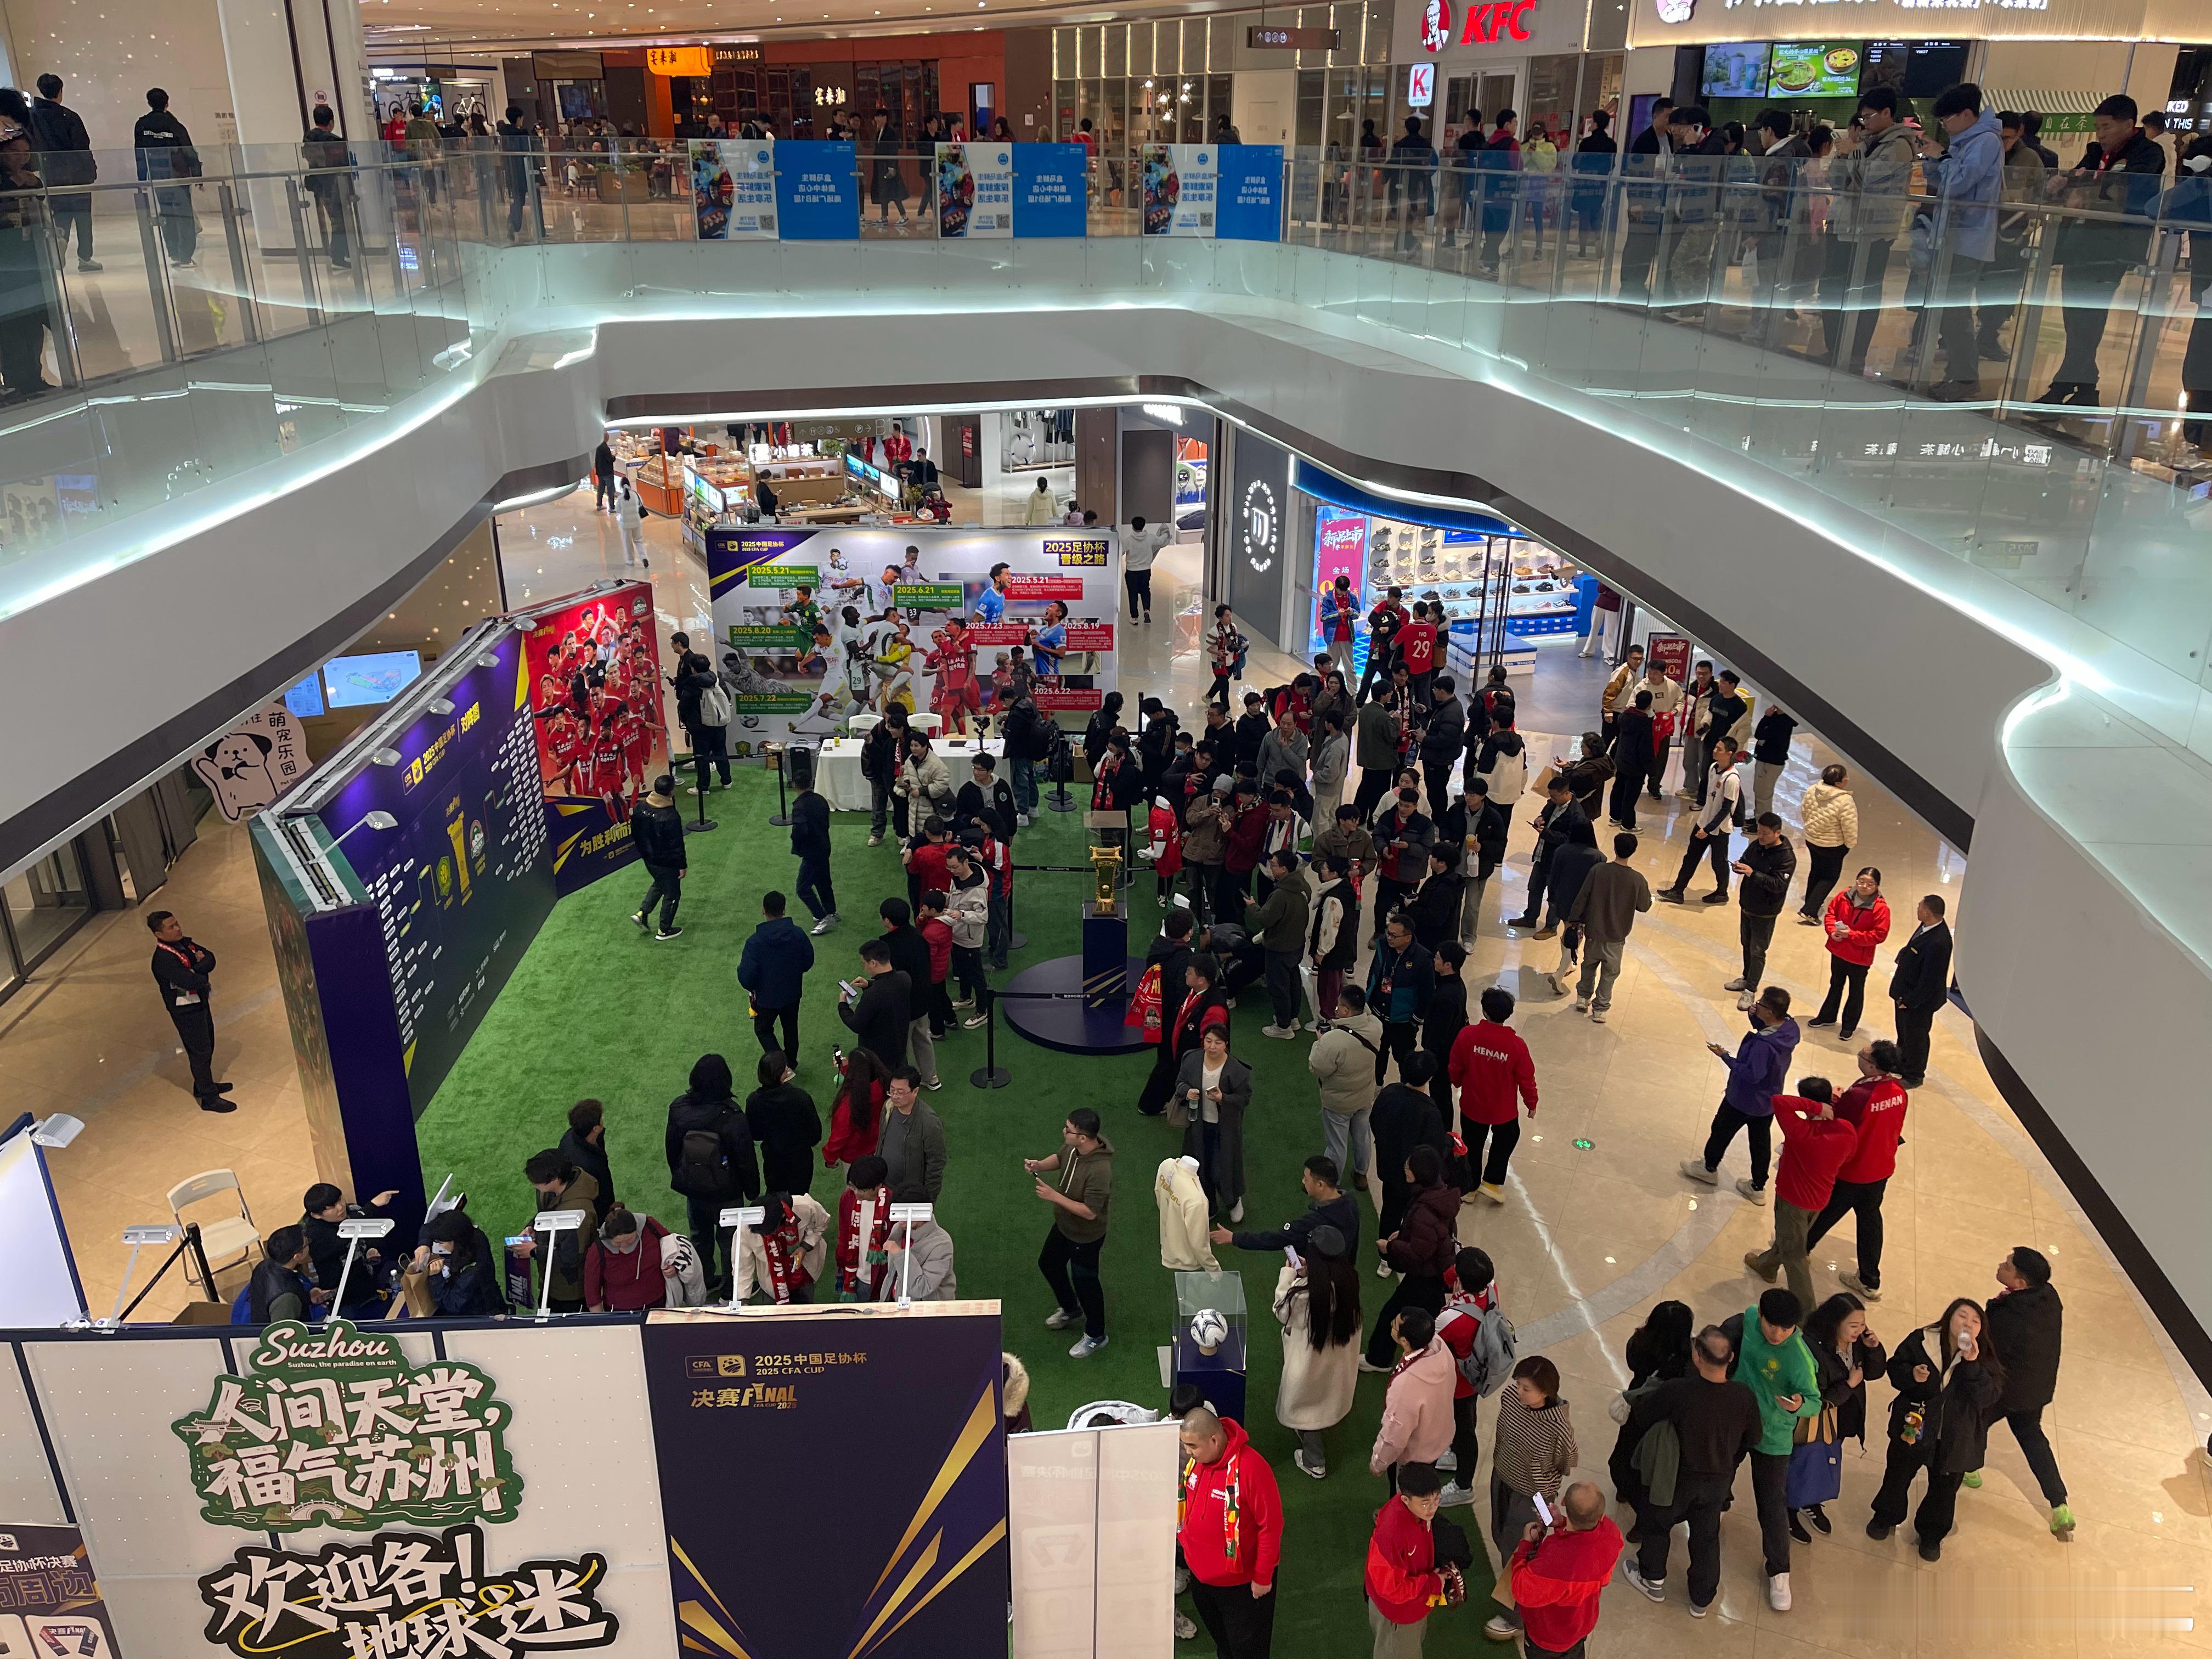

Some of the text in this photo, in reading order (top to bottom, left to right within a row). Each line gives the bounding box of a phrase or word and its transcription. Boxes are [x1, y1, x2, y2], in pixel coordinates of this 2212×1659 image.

[1460, 0, 1536, 45] KFC
[1413, 69, 1429, 97] K
[2174, 118, 2193, 129] THIS
[876, 418, 891, 436] B1
[1046, 542, 1105, 552] 2025足协杯
[1323, 526, 1363, 551] 新品上市
[1060, 554, 1105, 565] 晋级之路
[909, 608, 917, 617] 33
[1412, 640, 1430, 658] 29
[1657, 641, 1686, 654] 新品上市
[423, 701, 480, 765] 2025中国足协杯 对阵图
[269, 712, 297, 776] 萌宠乐园
[1474, 1045, 1508, 1062] HENAN
[1871, 1094, 1903, 1113] HENAN
[257, 1325, 390, 1367] Suzhou
[287, 1361, 319, 1369] Suzhou,
[320, 1359, 331, 1369] the
[332, 1359, 363, 1369] paradise
[377, 1358, 397, 1367] earth
[755, 1352, 867, 1367] 2025中国足协杯
[691, 1388, 741, 1408] 决赛
[203, 1431, 503, 1512] 福气苏州
